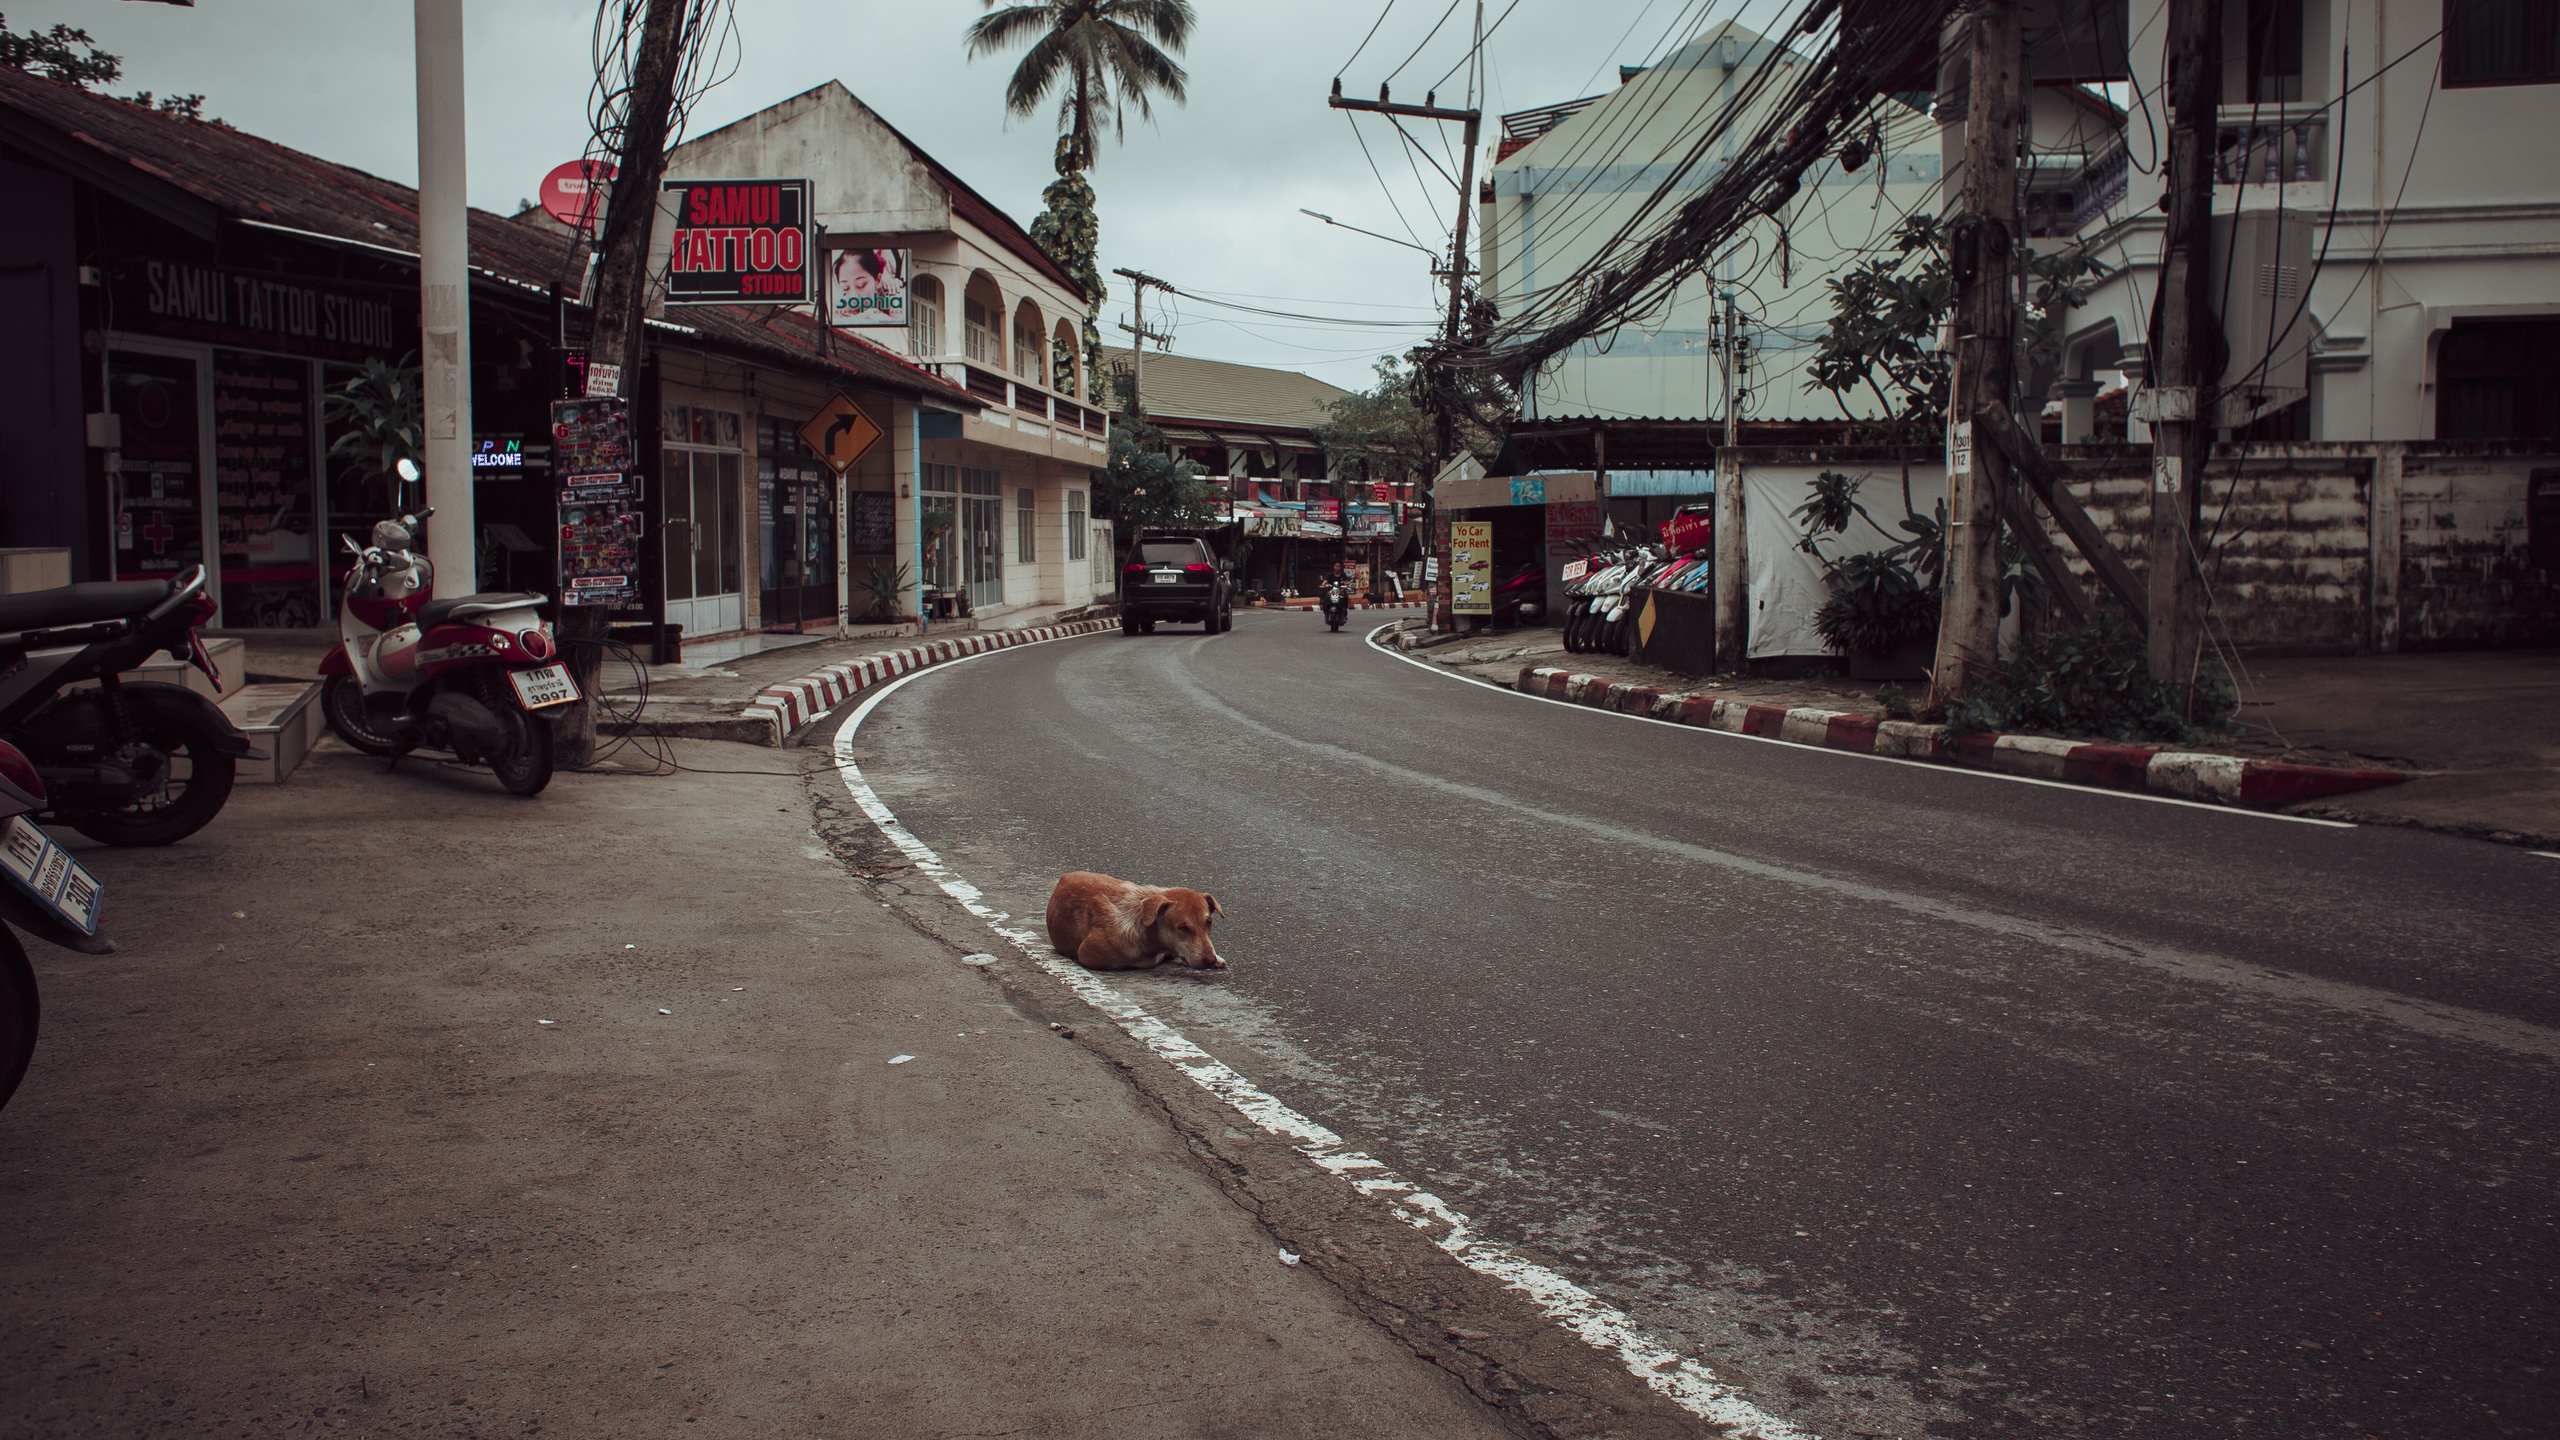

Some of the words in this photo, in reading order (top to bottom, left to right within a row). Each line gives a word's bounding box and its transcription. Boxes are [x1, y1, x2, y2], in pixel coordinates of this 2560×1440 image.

[565, 181, 586, 189] true
[689, 185, 780, 225] SAMUI
[671, 226, 803, 274] TATTOO
[742, 273, 803, 295] STUDIO
[147, 260, 228, 323] SAMUI
[234, 275, 317, 338] TATTOO
[324, 293, 393, 350] STUDIO
[556, 424, 569, 439] 6
[472, 453, 521, 466] WELCOME
[1957, 453, 1965, 466] 12
[561, 526, 574, 540] 6
[1456, 525, 1468, 537] Yo
[1469, 525, 1484, 537] Car
[1453, 537, 1467, 549] For
[1469, 537, 1490, 549] Rent
[1565, 564, 1573, 578] FOR
[1574, 561, 1586, 575] RENT
[531, 688, 567, 705] 3997
[66, 873, 95, 918] 300
